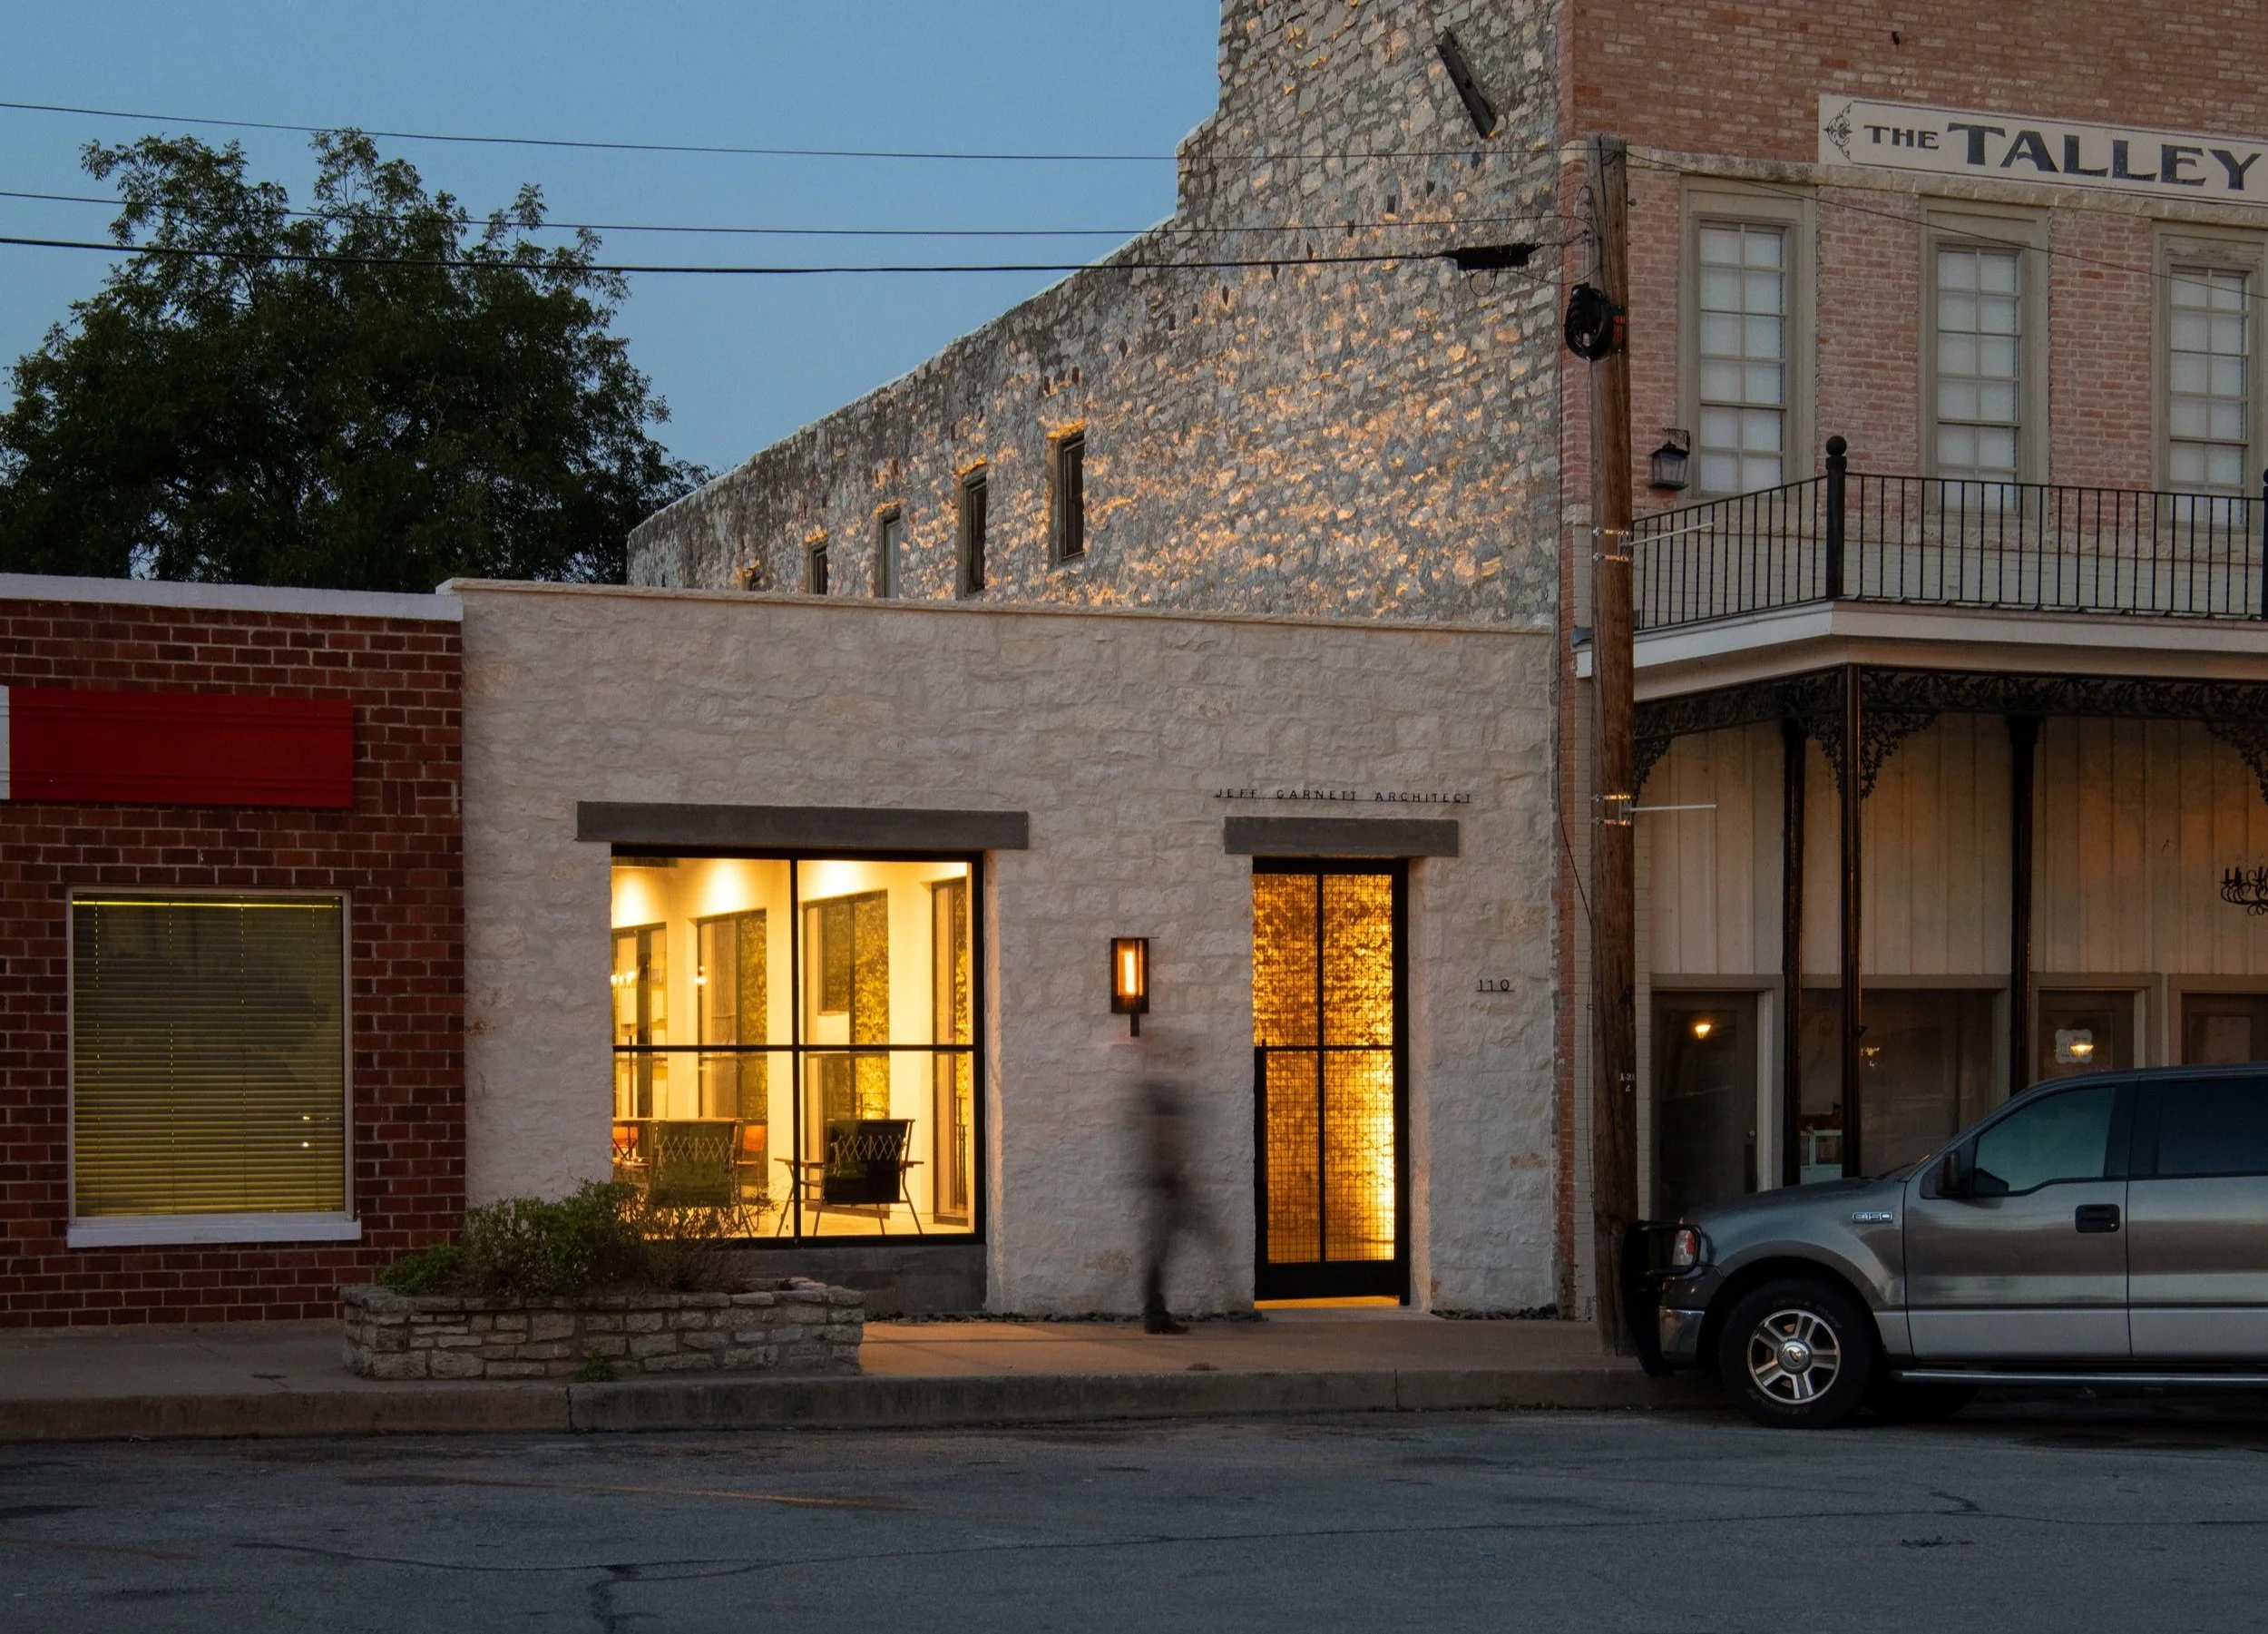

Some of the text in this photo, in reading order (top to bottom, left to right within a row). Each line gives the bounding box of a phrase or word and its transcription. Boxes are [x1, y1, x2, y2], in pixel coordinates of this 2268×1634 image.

[1863, 122, 2262, 191] THE TALLEY
[1216, 788, 1471, 804] JEFF GARNETT ARCHITECT
[1480, 979, 1510, 992] 110
